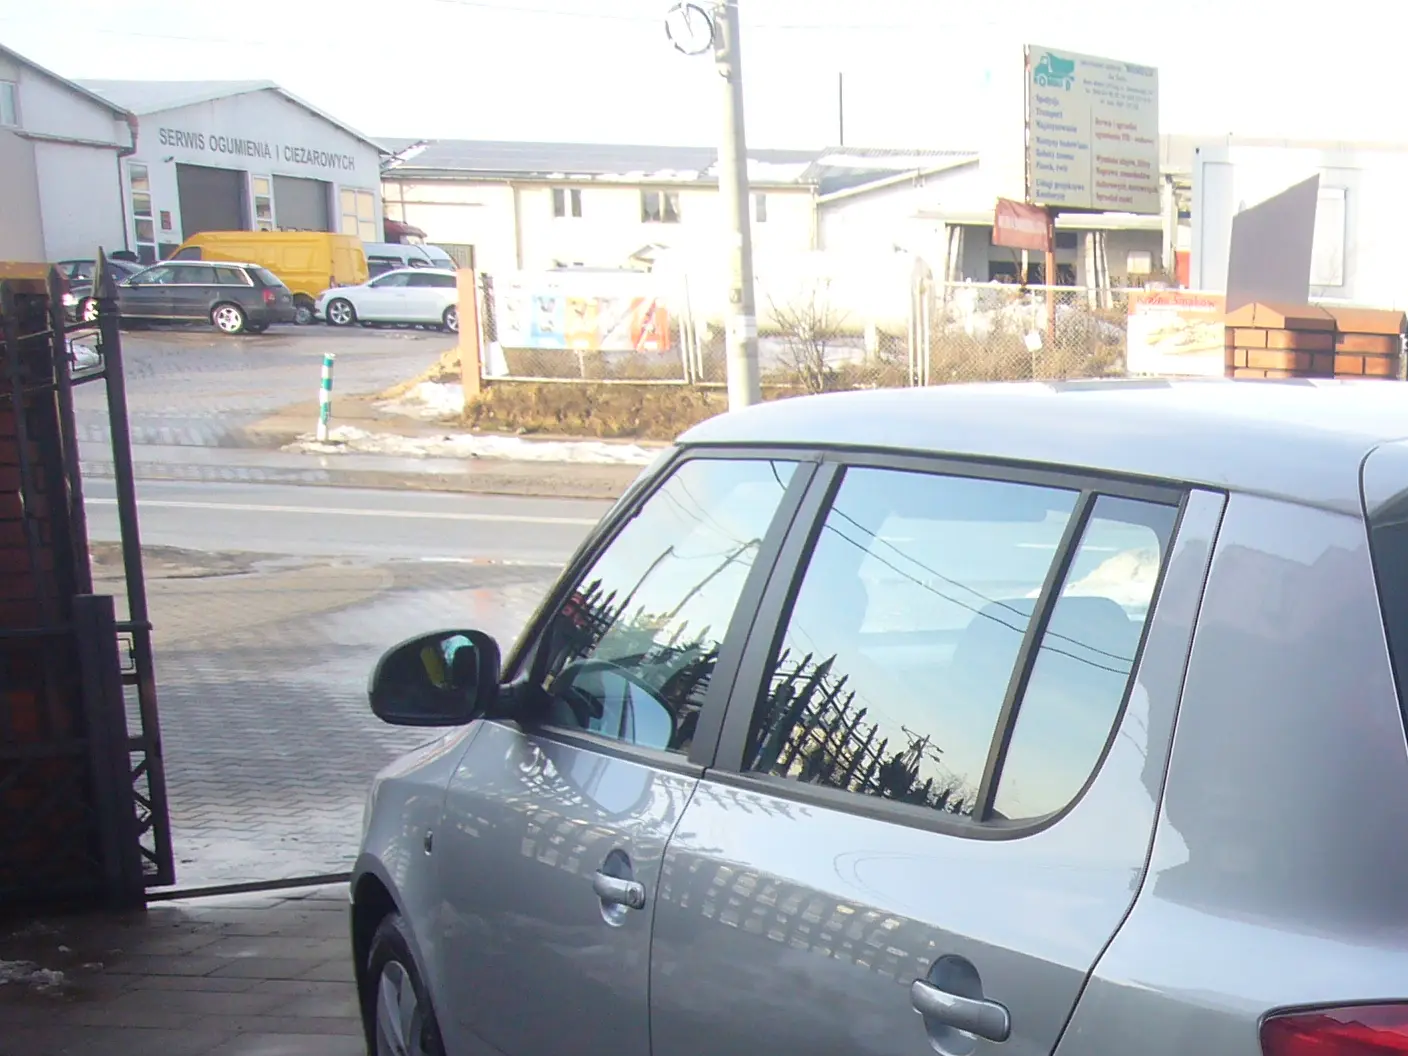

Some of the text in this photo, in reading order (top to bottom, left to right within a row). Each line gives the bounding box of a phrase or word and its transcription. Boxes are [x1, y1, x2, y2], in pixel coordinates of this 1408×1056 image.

[159, 128, 205, 151] SERWIS
[209, 135, 272, 160] OGUMIENIA
[275, 145, 280, 162] I
